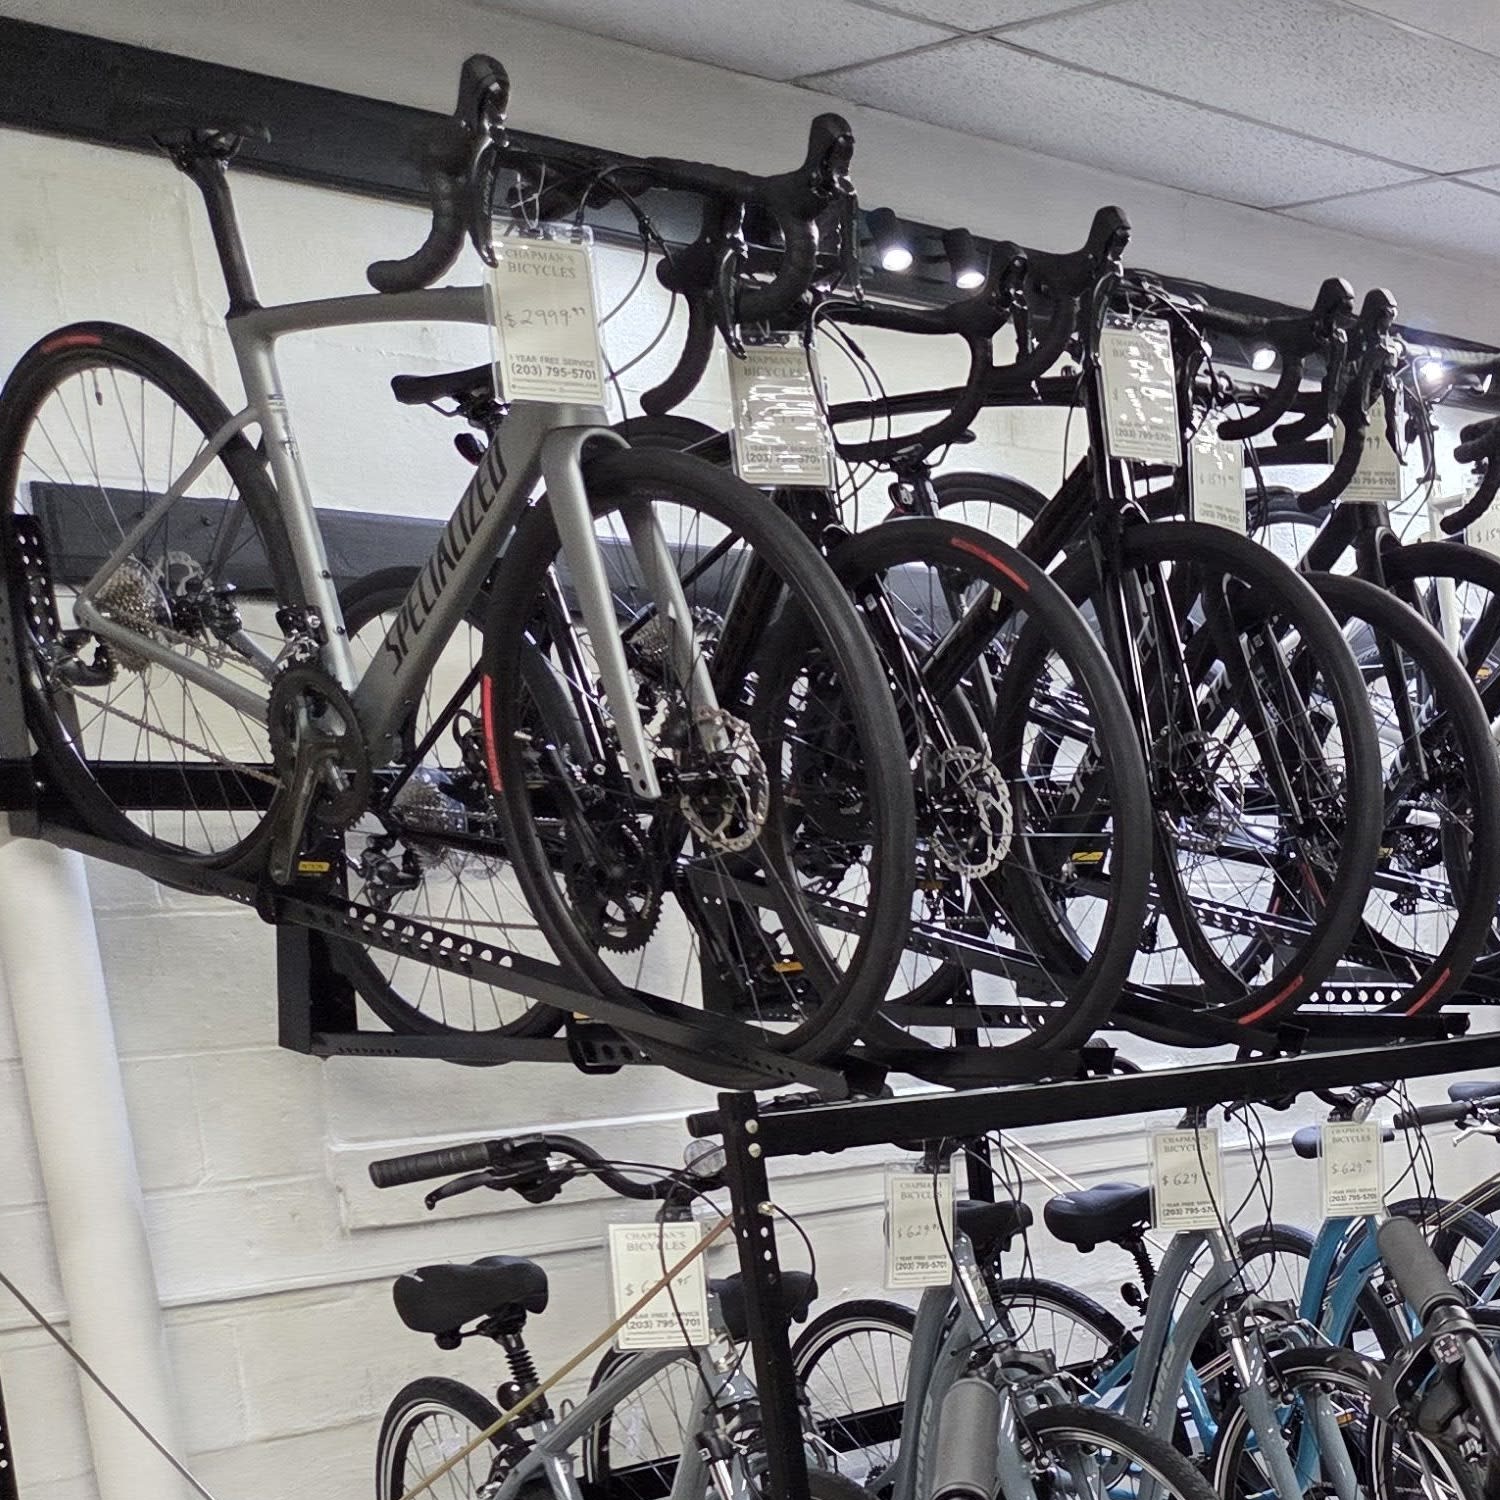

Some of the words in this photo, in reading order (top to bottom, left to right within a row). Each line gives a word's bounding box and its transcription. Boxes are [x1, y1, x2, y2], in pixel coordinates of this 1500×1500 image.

[507, 261, 577, 279] BICYCLES
[511, 362, 543, 377] (203)
[546, 365, 597, 381] 795-5701
[385, 432, 508, 676] SPECIALIZED
[626, 1320, 653, 1330] (203)
[656, 1318, 702, 1328] 795-701
